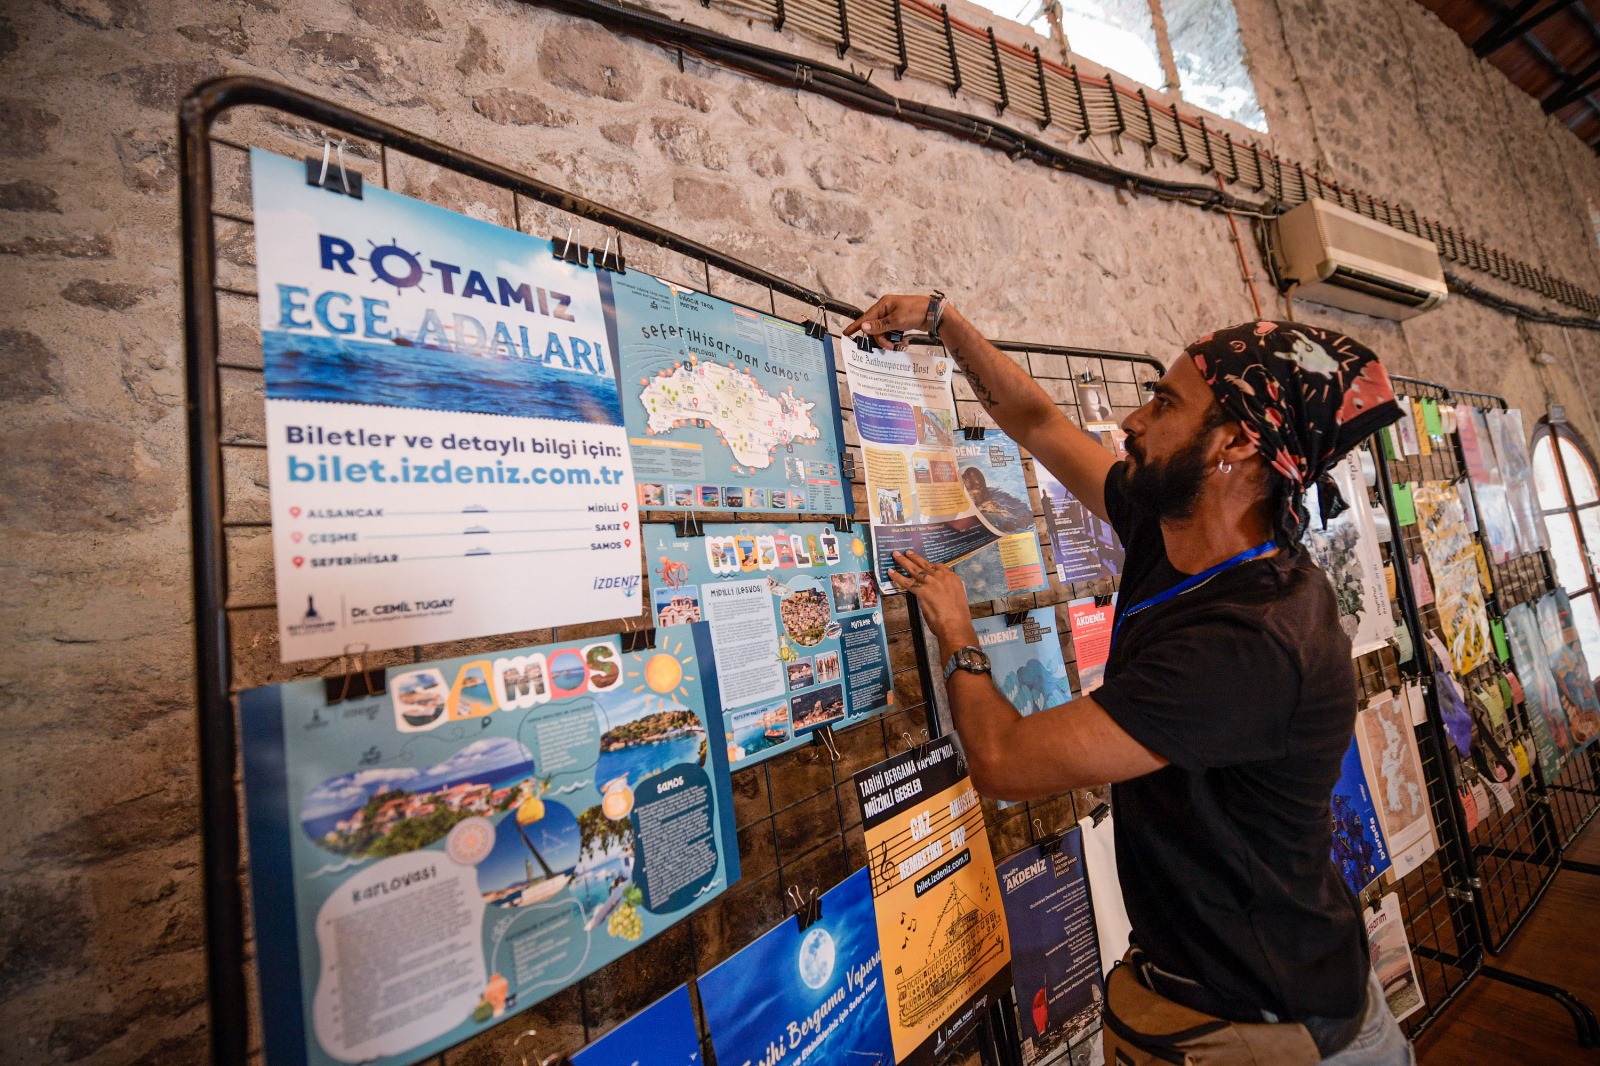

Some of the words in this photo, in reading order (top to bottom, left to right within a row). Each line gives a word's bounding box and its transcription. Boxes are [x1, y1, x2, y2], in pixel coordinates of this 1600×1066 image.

[317, 233, 575, 322] ROTAMIZ
[276, 283, 394, 340] EGE
[416, 307, 606, 376] ADALARI
[851, 349, 863, 364] The
[912, 362, 930, 375] Post
[286, 425, 395, 447] Biletler
[404, 434, 433, 450] ve
[441, 432, 525, 457] detaylı
[532, 437, 577, 459] bilgi
[583, 441, 622, 459] için:
[956, 443, 982, 457] DENİZ
[288, 455, 624, 486] bilet.izdeniz.com.tr
[307, 508, 384, 519] ALSANCAK
[588, 503, 620, 513] MİDİLLİ
[308, 531, 358, 545] ÇEŞME
[595, 522, 621, 532] SAKIZ
[310, 553, 399, 568] SEFERİHİSAR
[590, 540, 622, 551] SAMOS
[593, 574, 640, 591] İZDENİZ
[351, 607, 368, 618] Dr.
[373, 601, 412, 616] CEMİL
[415, 598, 455, 612] TUGAY
[1076, 611, 1106, 627] AKDENİZ
[978, 628, 1019, 646] AKDENİZ
[396, 644, 621, 730] SAMOS
[859, 772, 885, 798] TARİHİ
[884, 760, 917, 787] BERGAMA
[864, 790, 895, 819] MÜZİKLİ
[894, 778, 923, 804] GECELER
[909, 810, 933, 842] CAZ
[899, 839, 943, 881] REMBETİKO
[949, 825, 966, 852] POP
[915, 852, 969, 894] bilet.izdeniz.com.tr
[1006, 858, 1048, 892] AKDENİZ
[786, 986, 846, 1050] Bergama
